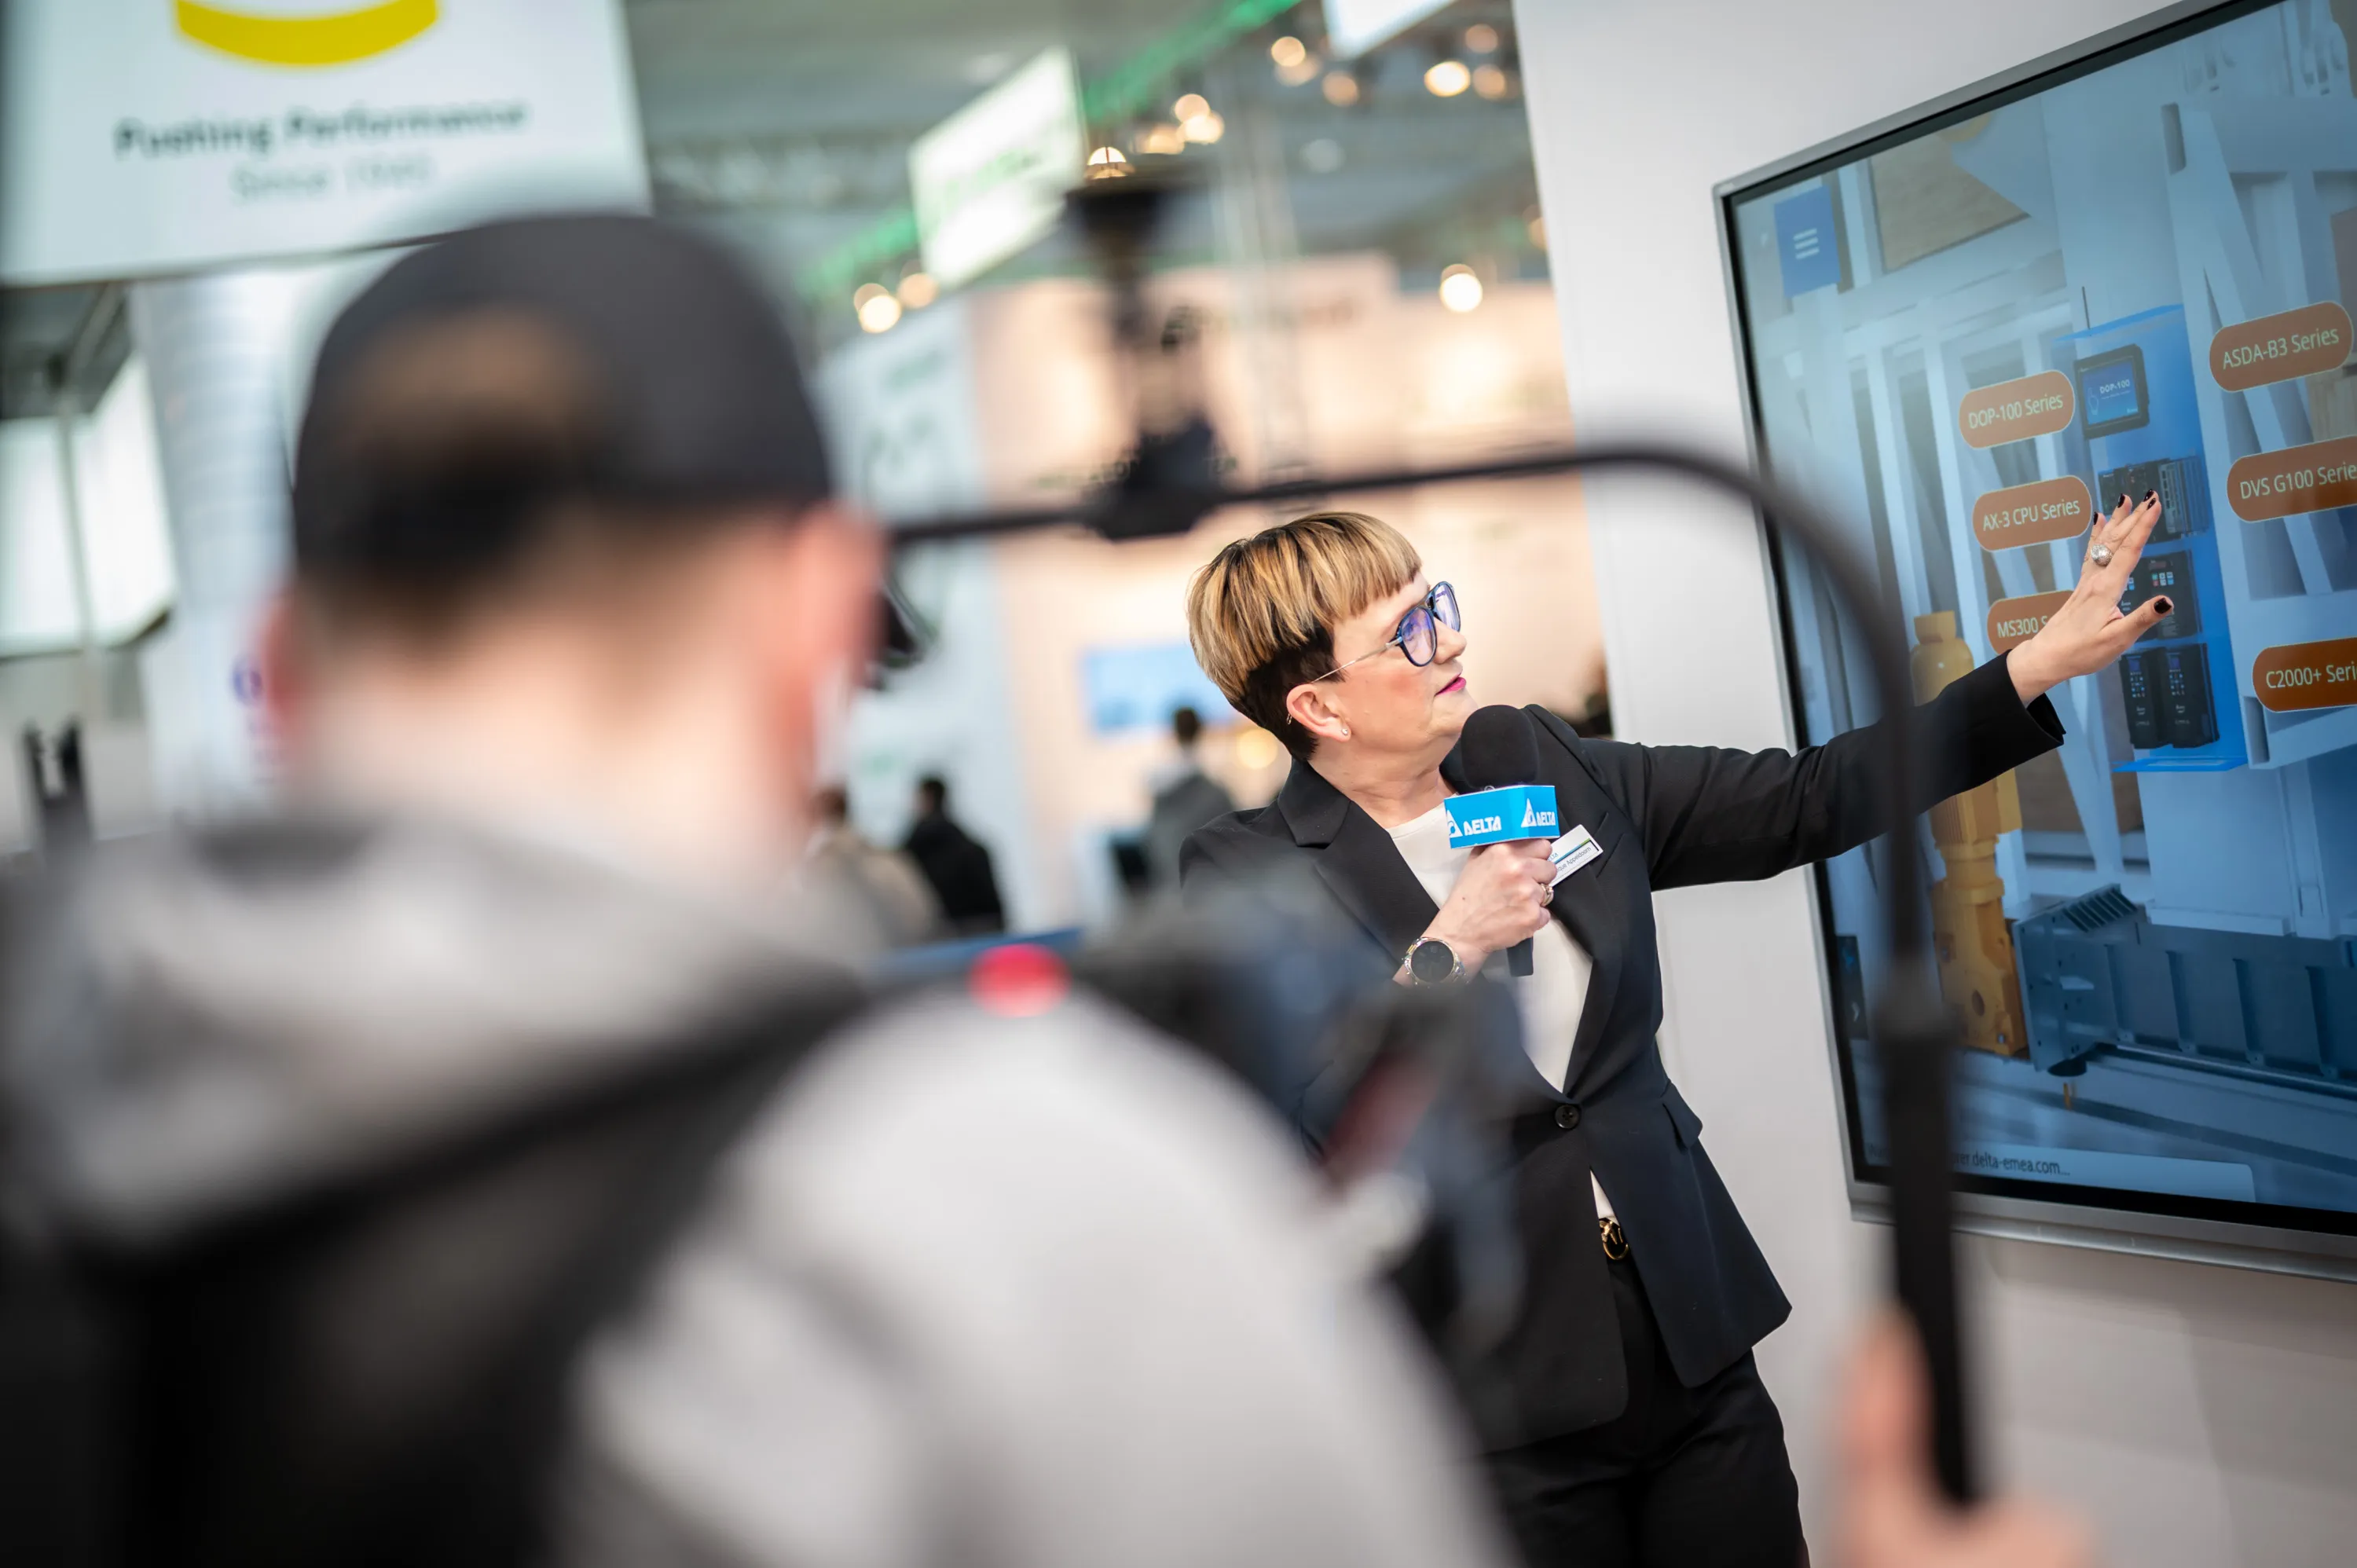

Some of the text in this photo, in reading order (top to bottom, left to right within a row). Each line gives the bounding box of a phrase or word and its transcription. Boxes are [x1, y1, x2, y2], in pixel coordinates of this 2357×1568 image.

[2223, 328, 2339, 370] ASDA-B3 Series
[2099, 379, 2130, 394] DOP-100
[1968, 394, 2063, 429] DOP-100 Series
[2240, 461, 2357, 500] DVS G100 Serie
[1982, 499, 2080, 532] AX-3 CPU Series
[1996, 617, 2039, 638] MS300
[2266, 661, 2357, 689] C2000+ Seri
[1464, 815, 1502, 836] DELTA
[1536, 811, 1556, 826] DELTA
[1548, 852, 1559, 862] ELTA
[1567, 846, 1592, 866] Appeldoorn
